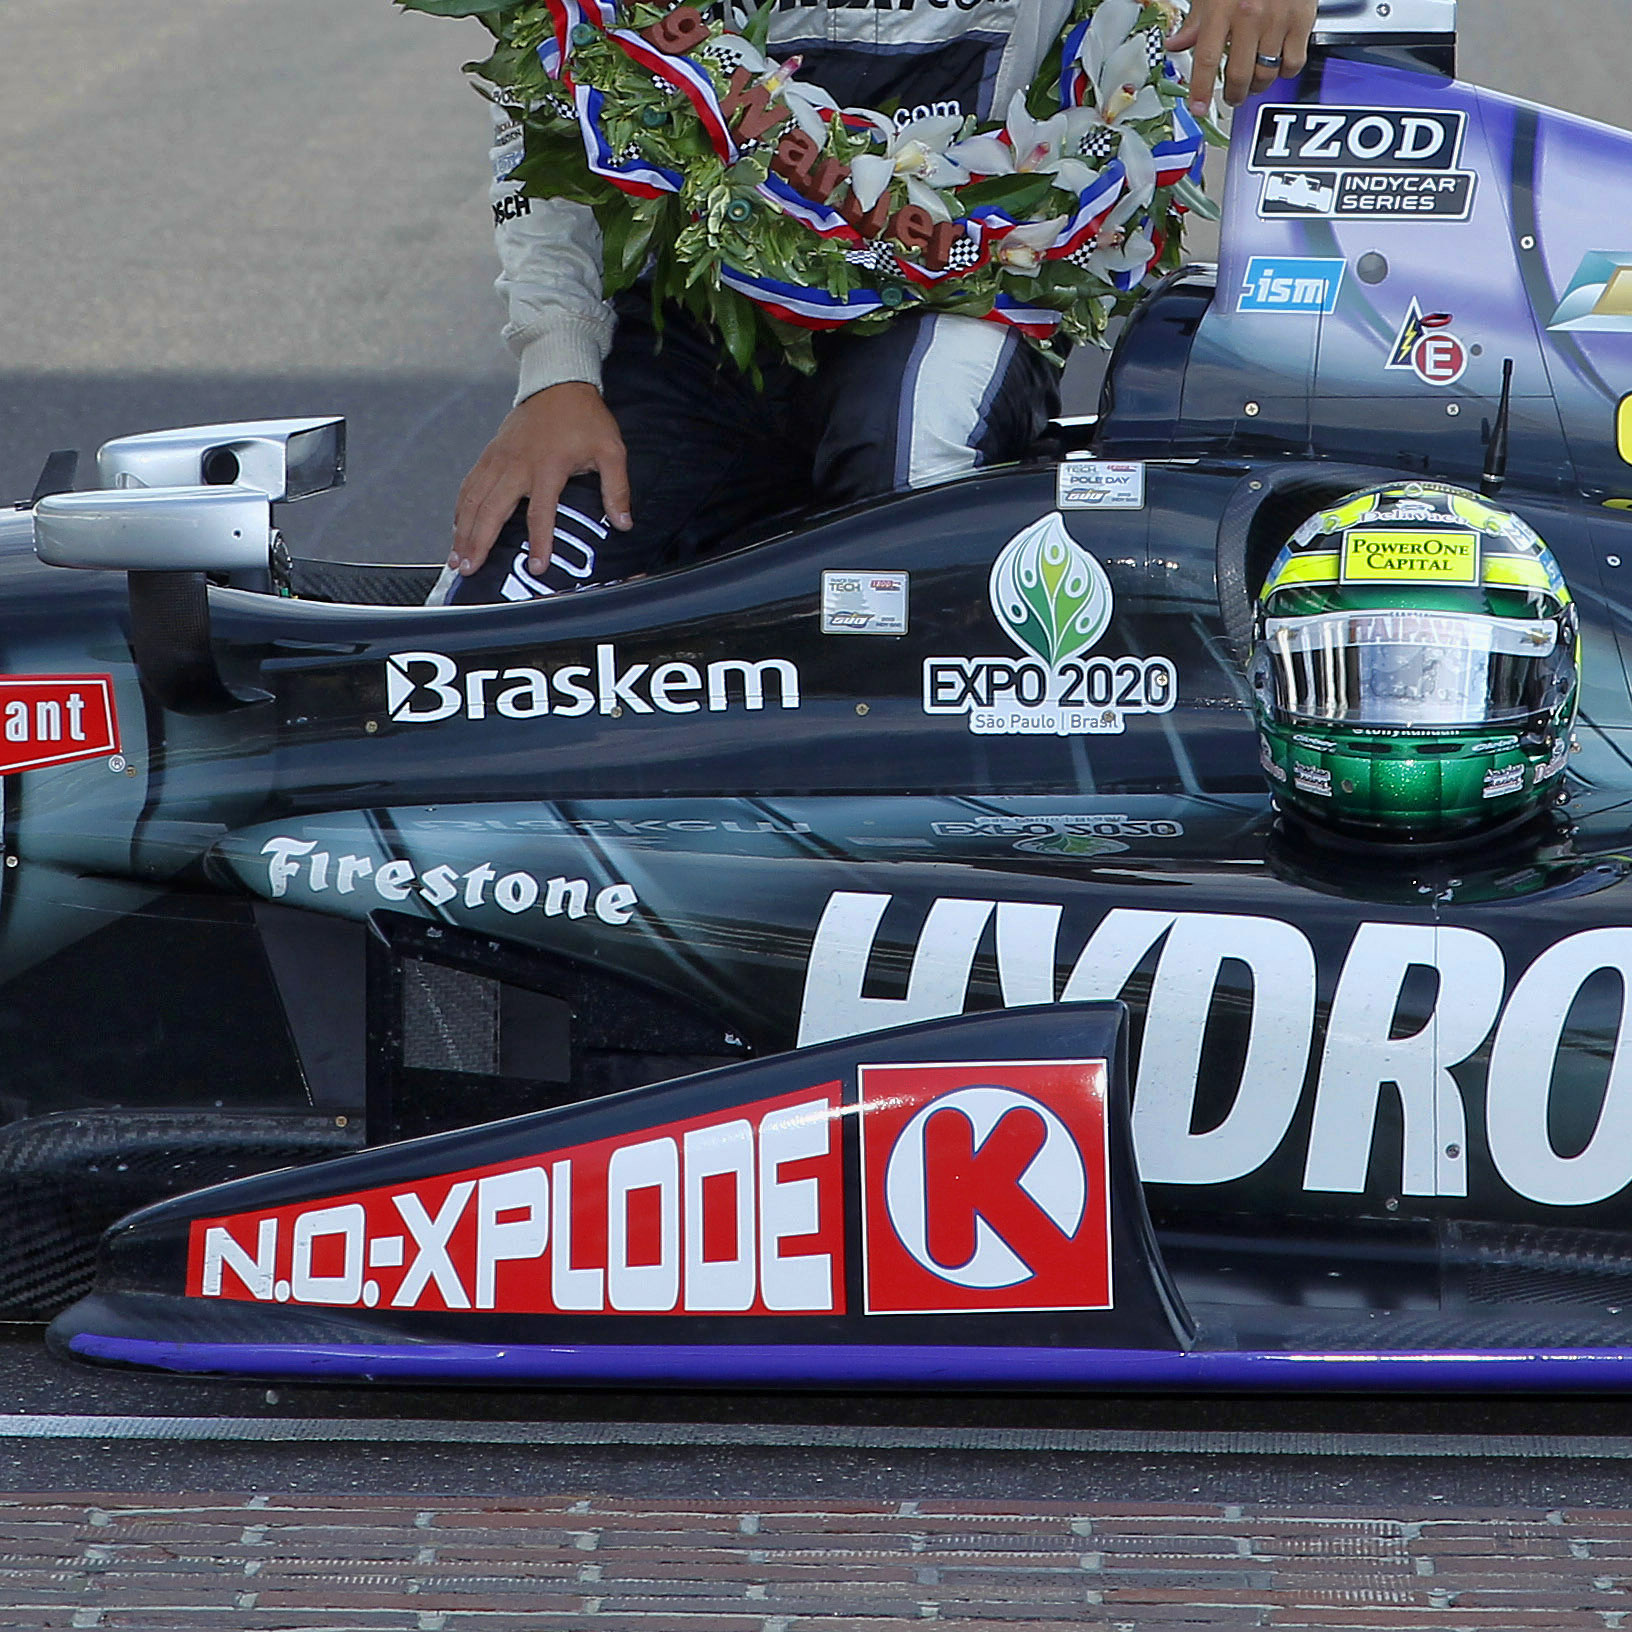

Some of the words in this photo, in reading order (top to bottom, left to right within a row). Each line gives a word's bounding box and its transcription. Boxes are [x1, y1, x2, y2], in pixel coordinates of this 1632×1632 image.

[1266, 114, 1445, 160] IZOD
[1342, 195, 1436, 210] SERIES
[1345, 176, 1456, 193] INDYCAR
[1256, 269, 1330, 304] ism
[387, 644, 800, 722] Braskem
[931, 663, 1046, 708] EXPO
[1058, 663, 1171, 708] 2020
[975, 714, 1005, 728] São
[1010, 714, 1056, 728] Paulo
[261, 836, 640, 925] Firestone
[201, 1098, 832, 1311] N.O.-XPLODE
[924, 1106, 1066, 1270] K
